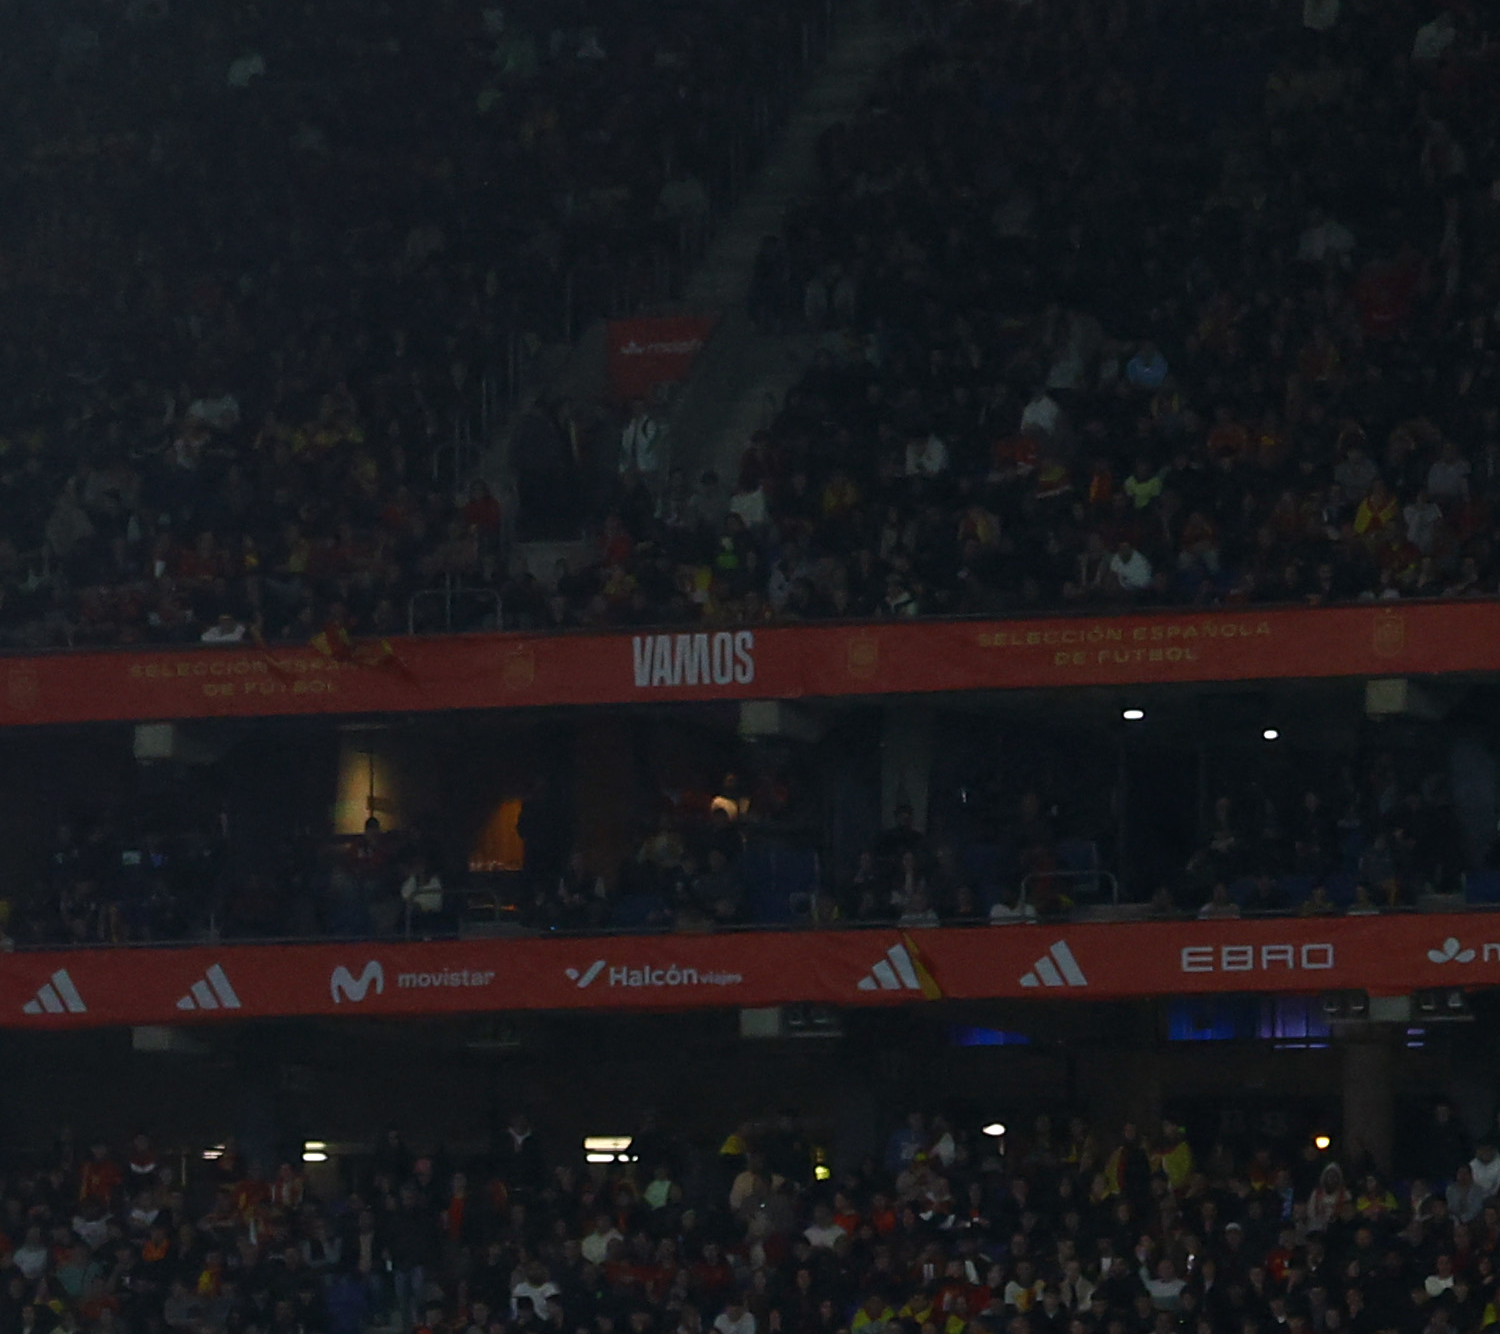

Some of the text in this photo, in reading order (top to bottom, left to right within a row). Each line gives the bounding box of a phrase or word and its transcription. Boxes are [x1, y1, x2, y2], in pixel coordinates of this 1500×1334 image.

[632, 629, 754, 687] VAMOS
[397, 967, 496, 988] movistar
[609, 964, 698, 986] Halcón
